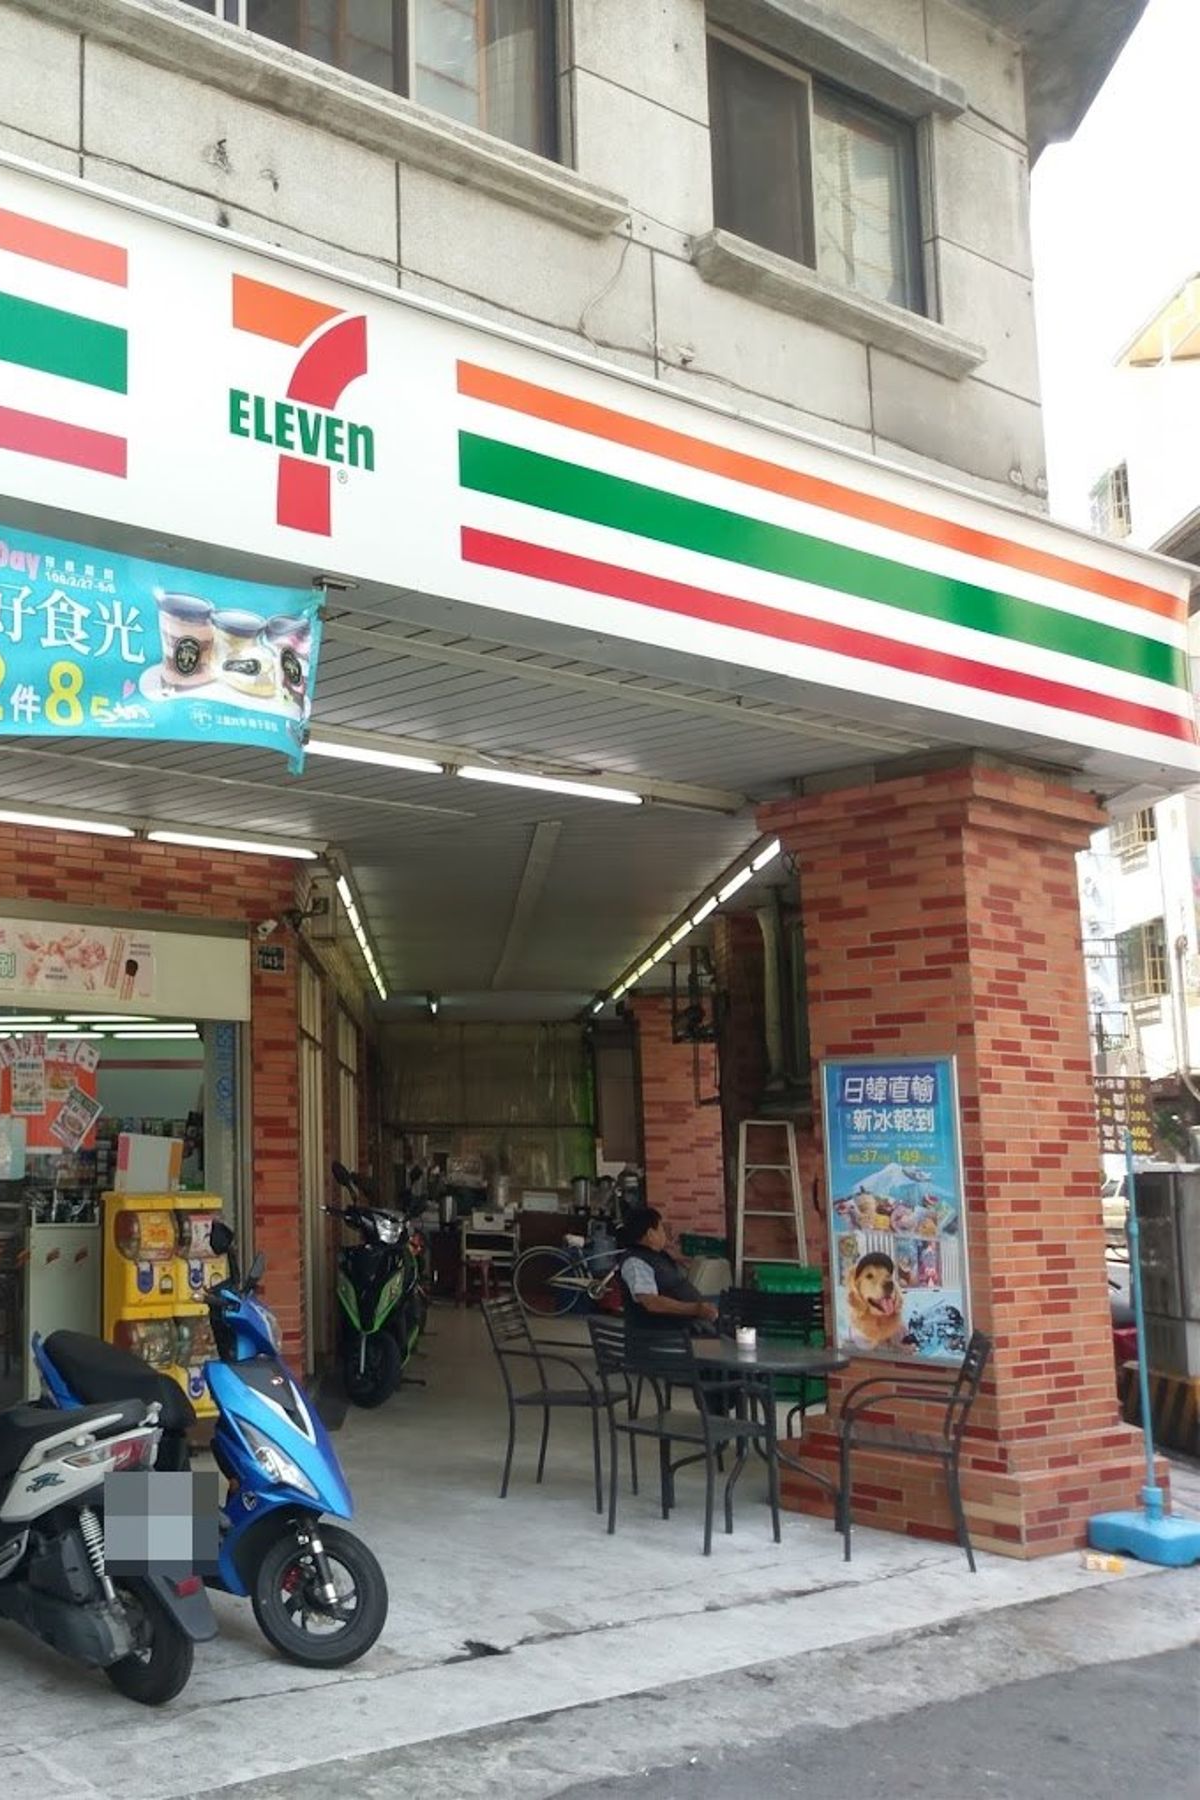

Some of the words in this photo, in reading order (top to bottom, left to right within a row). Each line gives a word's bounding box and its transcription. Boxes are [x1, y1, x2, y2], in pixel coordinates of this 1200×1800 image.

[232, 273, 367, 537] 7
[844, 1075, 935, 1103] 日韓直輸
[853, 1108, 935, 1133] 新冰報到
